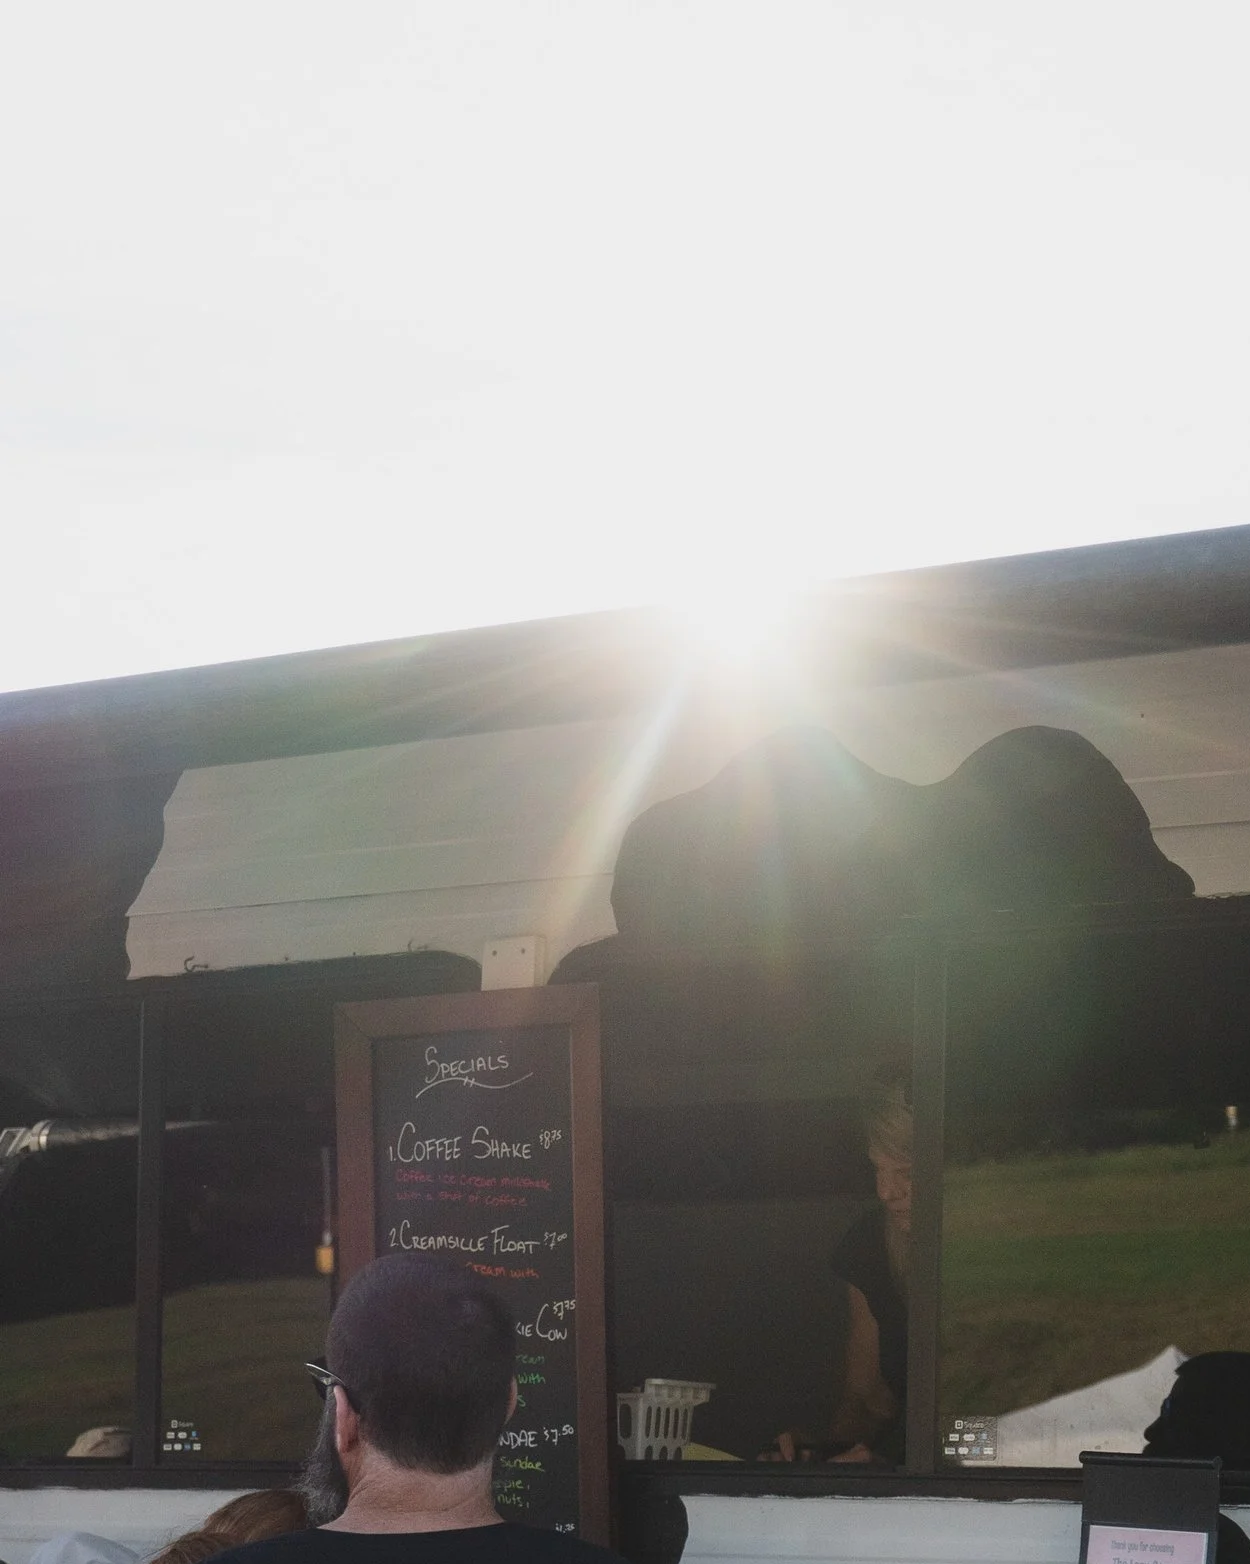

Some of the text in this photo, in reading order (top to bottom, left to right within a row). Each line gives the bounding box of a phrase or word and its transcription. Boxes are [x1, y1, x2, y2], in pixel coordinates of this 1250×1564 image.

[425, 1046, 510, 1084] SPECIALS
[471, 1125, 532, 1160] SHAKE
[491, 1224, 541, 1256] FLOAT
